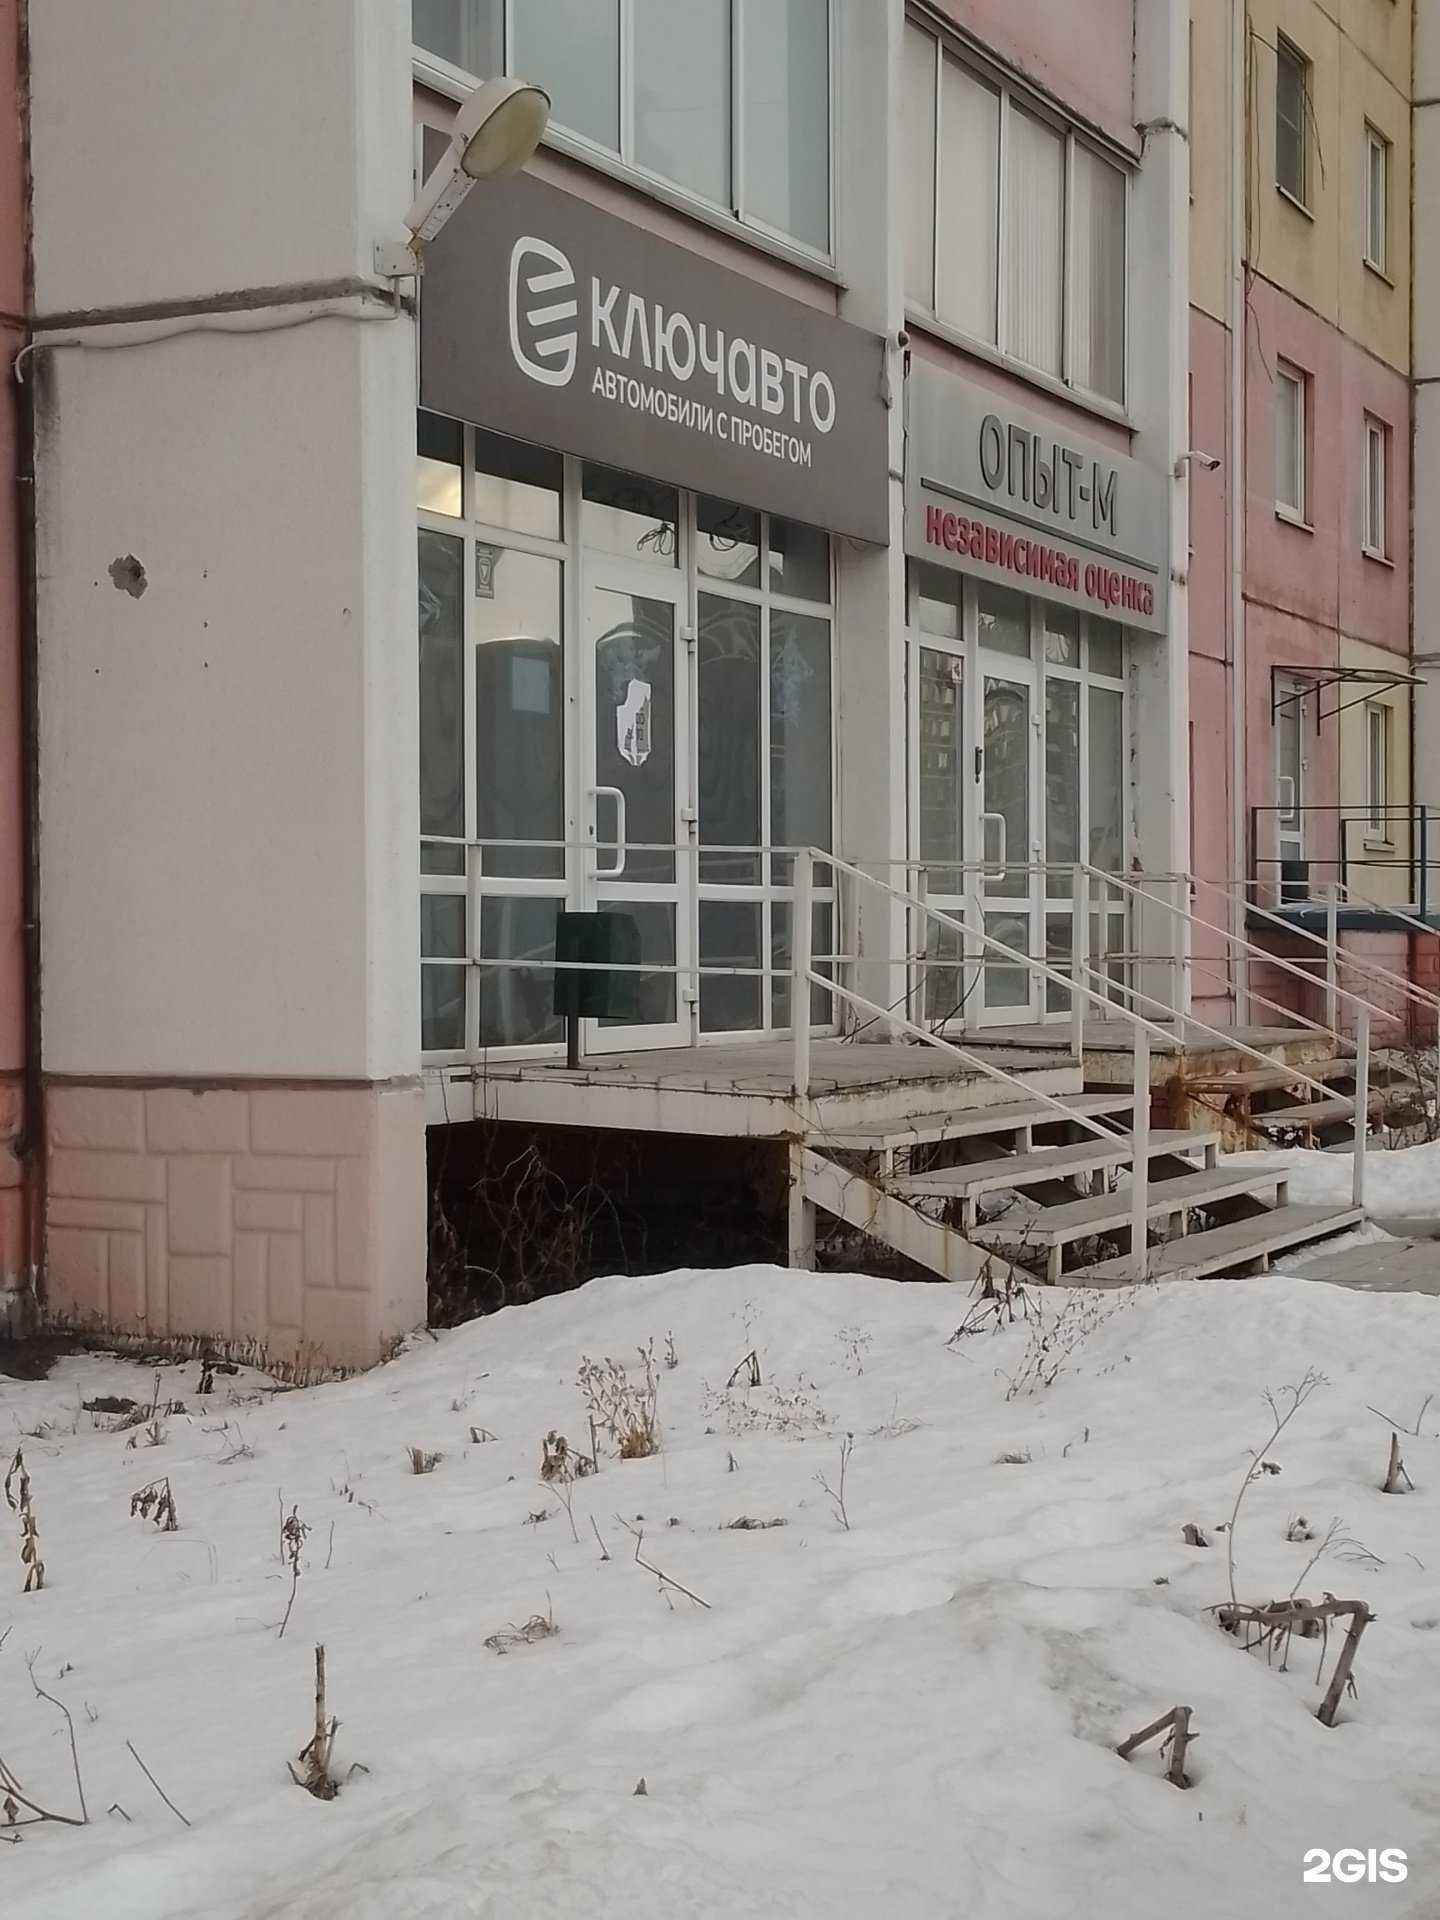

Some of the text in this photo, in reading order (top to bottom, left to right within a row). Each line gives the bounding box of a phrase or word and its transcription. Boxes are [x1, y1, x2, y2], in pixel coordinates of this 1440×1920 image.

[592, 366, 813, 469] АВТОМОБИЛИ С ПРОБЕГОМ
[979, 414, 1118, 537] ОПЫТ-М
[926, 504, 1154, 616] независимая оценка
